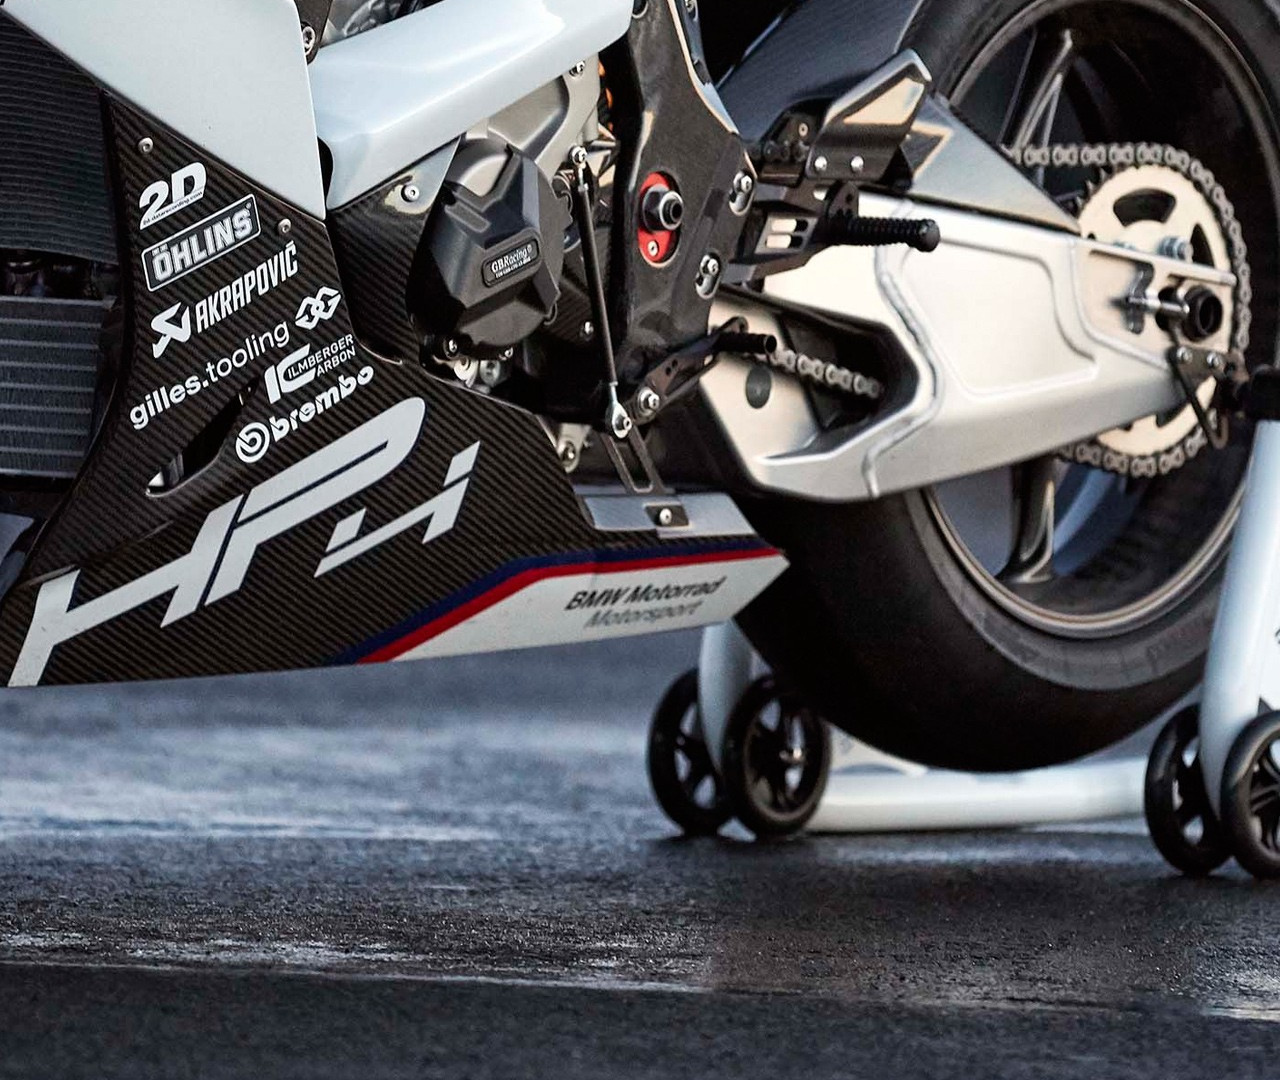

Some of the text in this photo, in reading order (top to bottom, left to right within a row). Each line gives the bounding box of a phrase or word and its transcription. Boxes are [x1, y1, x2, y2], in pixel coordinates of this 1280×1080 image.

[139, 162, 207, 230] 2D
[151, 208, 253, 281] ÖHLINS
[130, 321, 290, 430] gilles.tooling
[287, 333, 354, 380] ILMBERGER
[269, 365, 374, 442] brembo
[7, 395, 481, 687] HP4
[564, 575, 727, 611] BMW Motorrad
[583, 600, 703, 629] Motorsport
